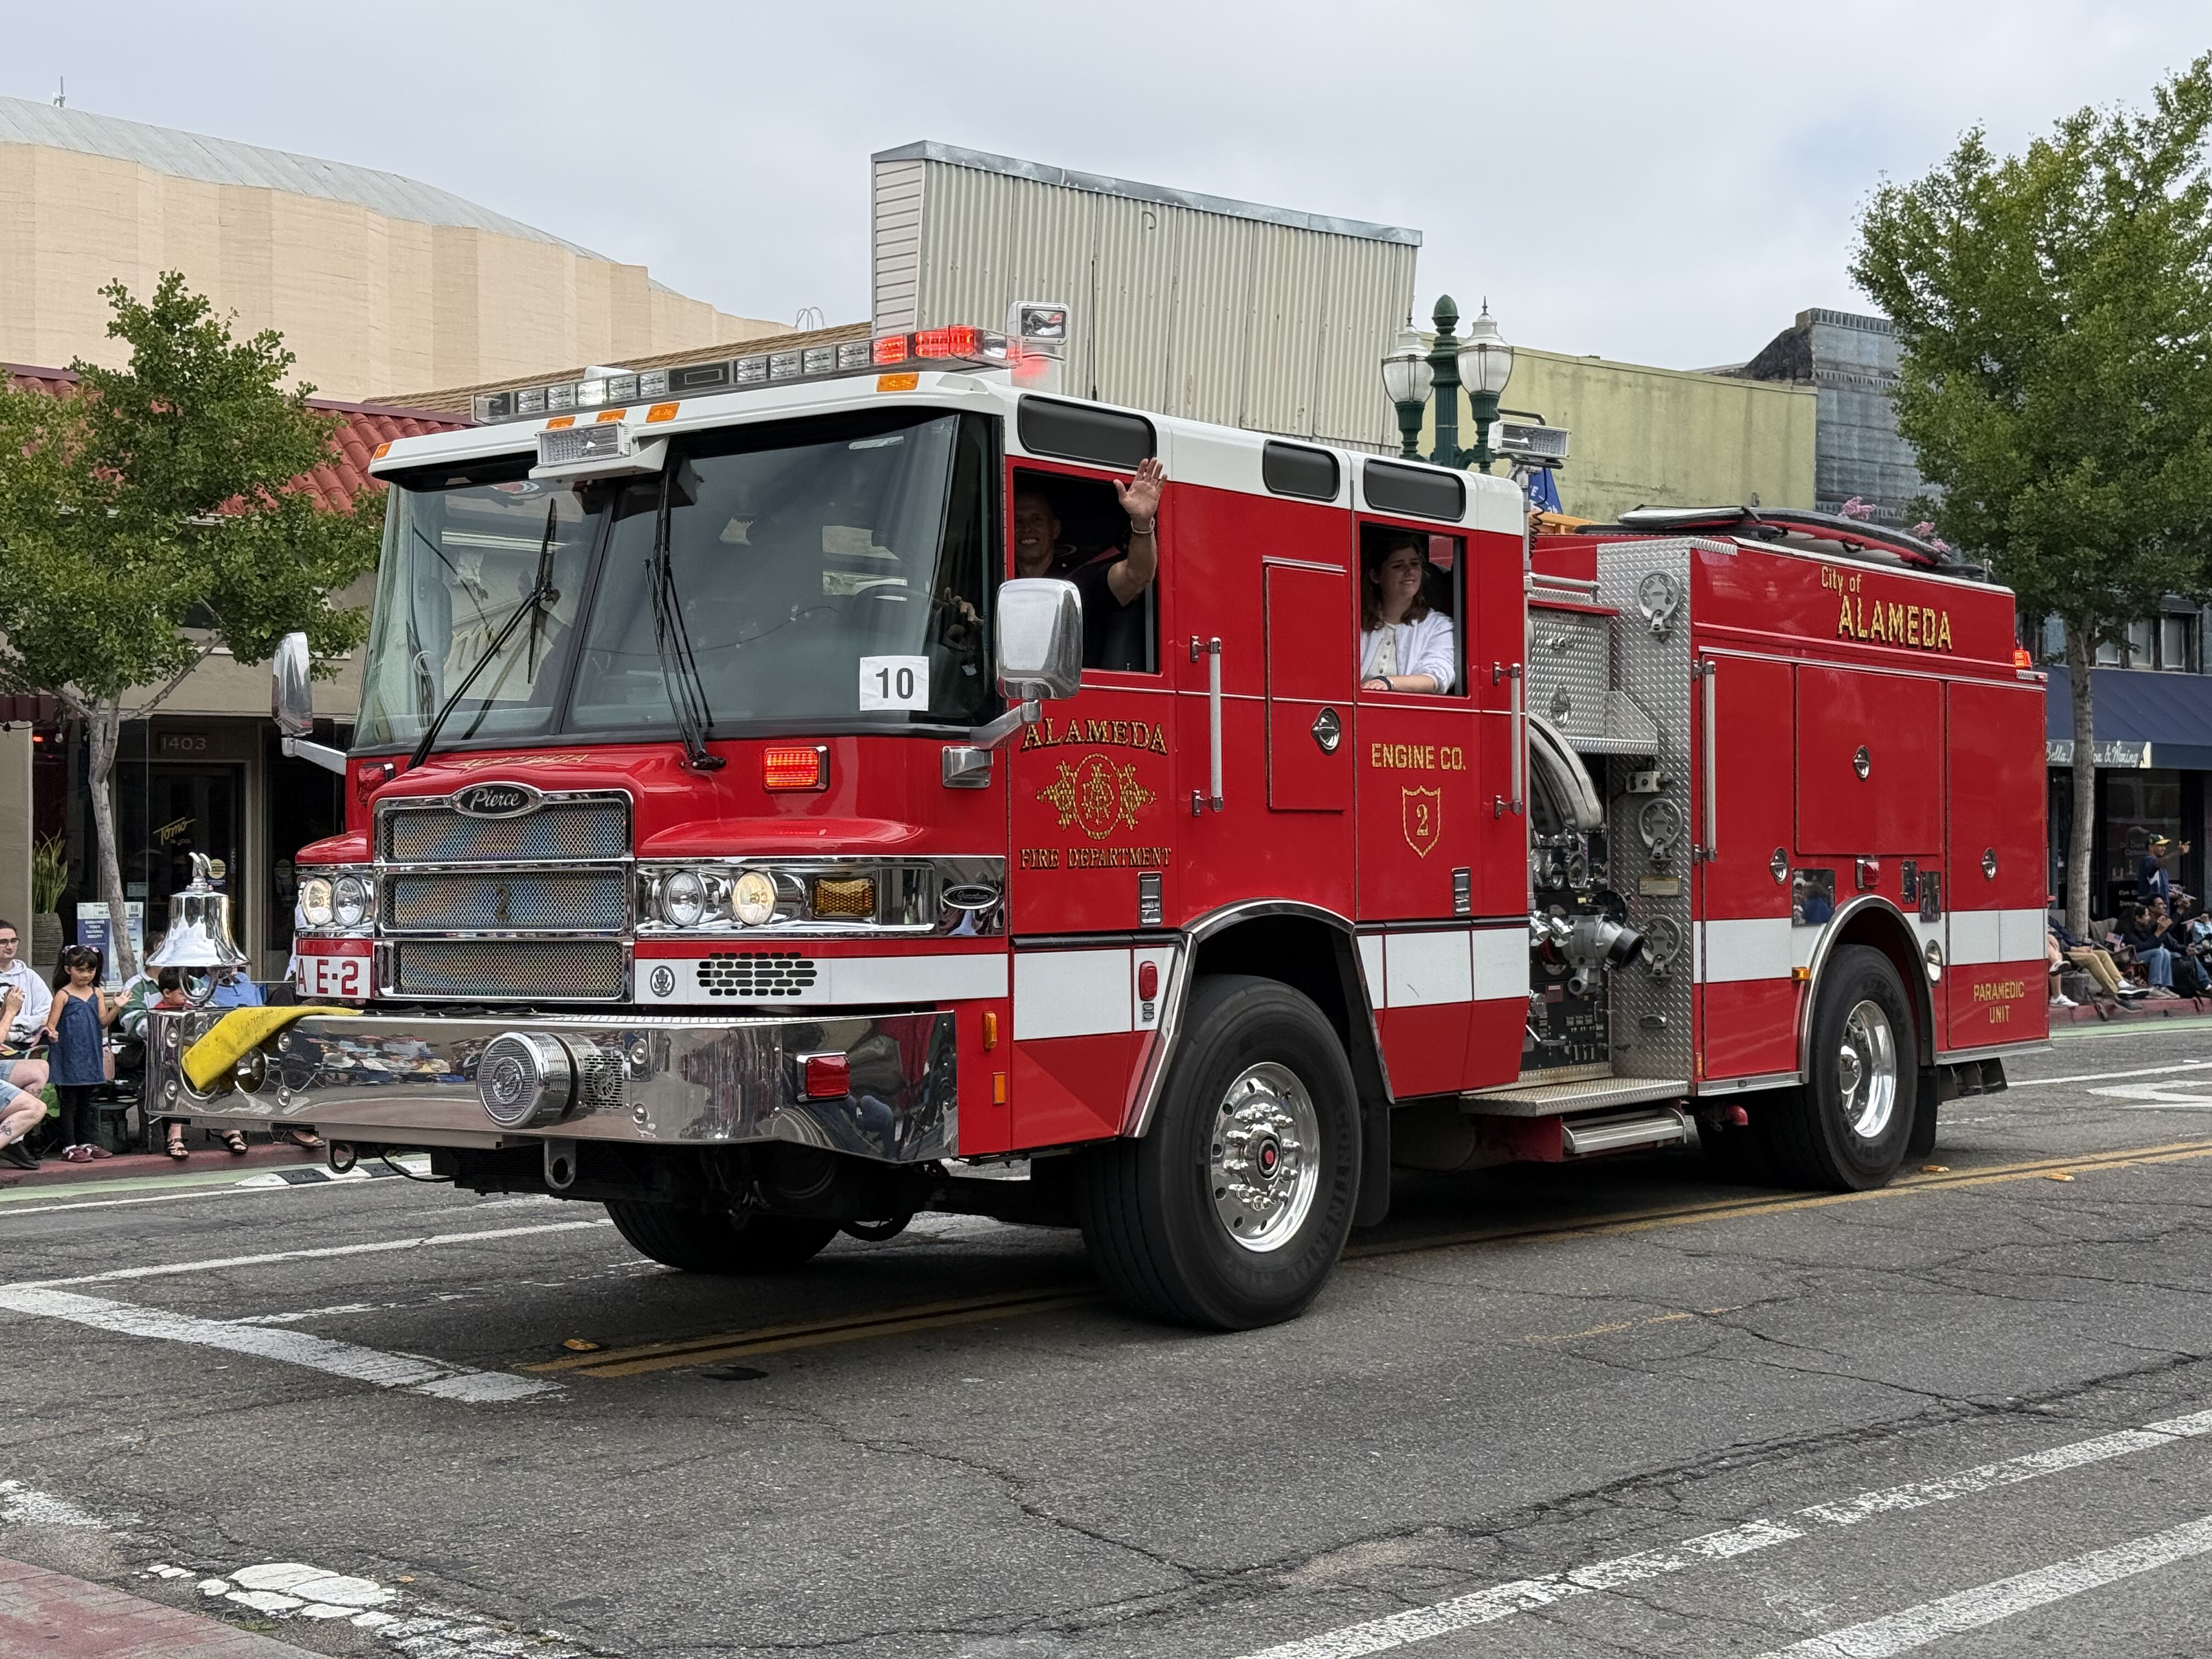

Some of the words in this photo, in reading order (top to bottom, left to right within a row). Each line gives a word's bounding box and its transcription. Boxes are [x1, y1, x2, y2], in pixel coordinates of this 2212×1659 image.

[1821, 565, 1844, 597] City
[1849, 573, 1863, 594] of
[1837, 595, 1953, 652] ALAMEDA
[875, 667, 914, 699] 10
[162, 737, 206, 750] 1403
[1021, 718, 1169, 755] ALAMEDA
[1371, 743, 1435, 770] ENGINE
[1440, 746, 1467, 771] CO.
[2104, 743, 2112, 764] &
[469, 788, 521, 811] Pierce
[152, 816, 197, 846] Tomo
[1416, 803, 1430, 837] 2
[1020, 848, 1060, 870] FIRE
[1068, 847, 1172, 869] DEPARTMENT
[495, 884, 510, 920] 2
[1973, 980, 2025, 1002] PARAMEDIC
[1989, 1005, 2011, 1024] UNIT
